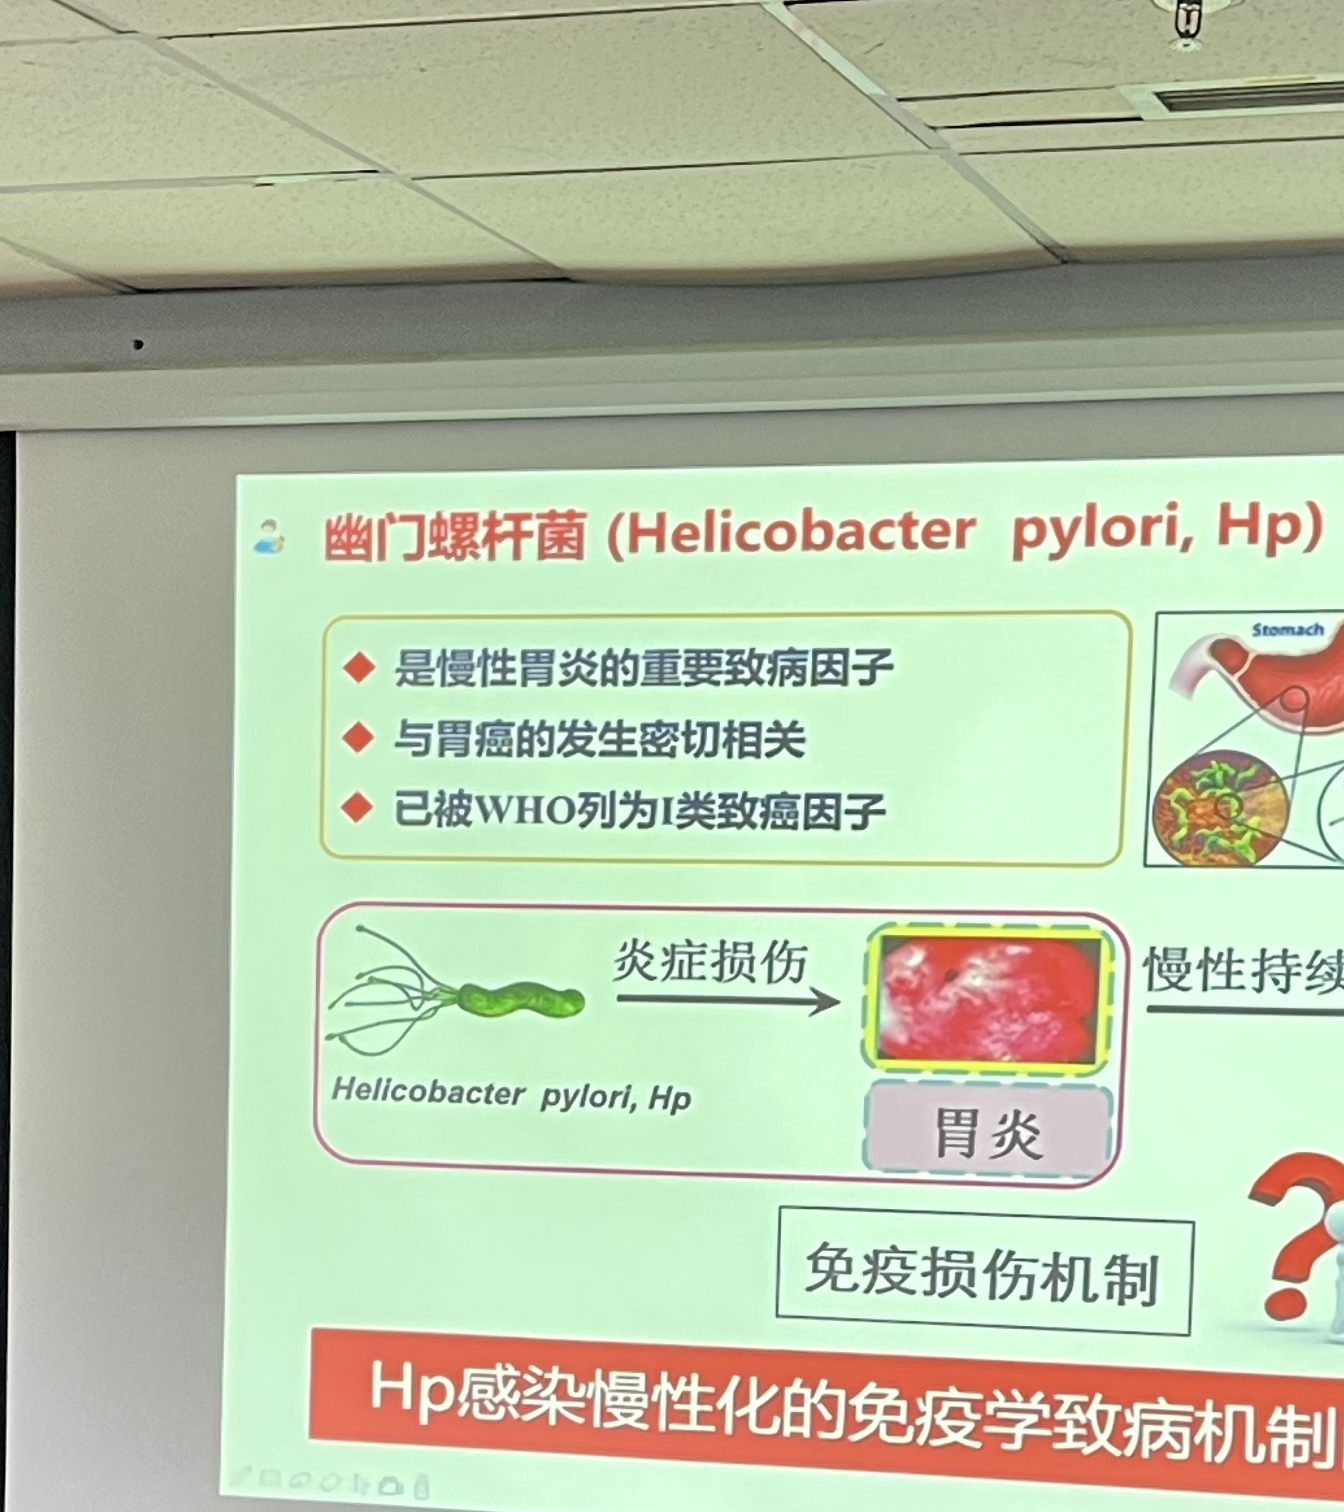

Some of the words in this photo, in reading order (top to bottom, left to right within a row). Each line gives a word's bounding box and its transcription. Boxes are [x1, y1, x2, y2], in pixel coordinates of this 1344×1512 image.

[324, 508, 587, 562] 幽门螺杆菌
[607, 507, 977, 563] (Helicobacter
[1011, 502, 1195, 561] pylori,
[1217, 502, 1324, 557] Hp)
[1251, 622, 1325, 638] Stomach
[396, 647, 894, 687] 是慢性胃炎的重要致病因子
[395, 719, 805, 759] 与胃癌的发生密切相关
[613, 936, 809, 984] 炎症损伤
[333, 1077, 526, 1105] Helicobacter
[541, 1084, 636, 1113] pylori,
[649, 1086, 690, 1115] Hp
[938, 1108, 1043, 1160] 胃炎
[806, 1242, 1158, 1307] 免疫损伤机制
